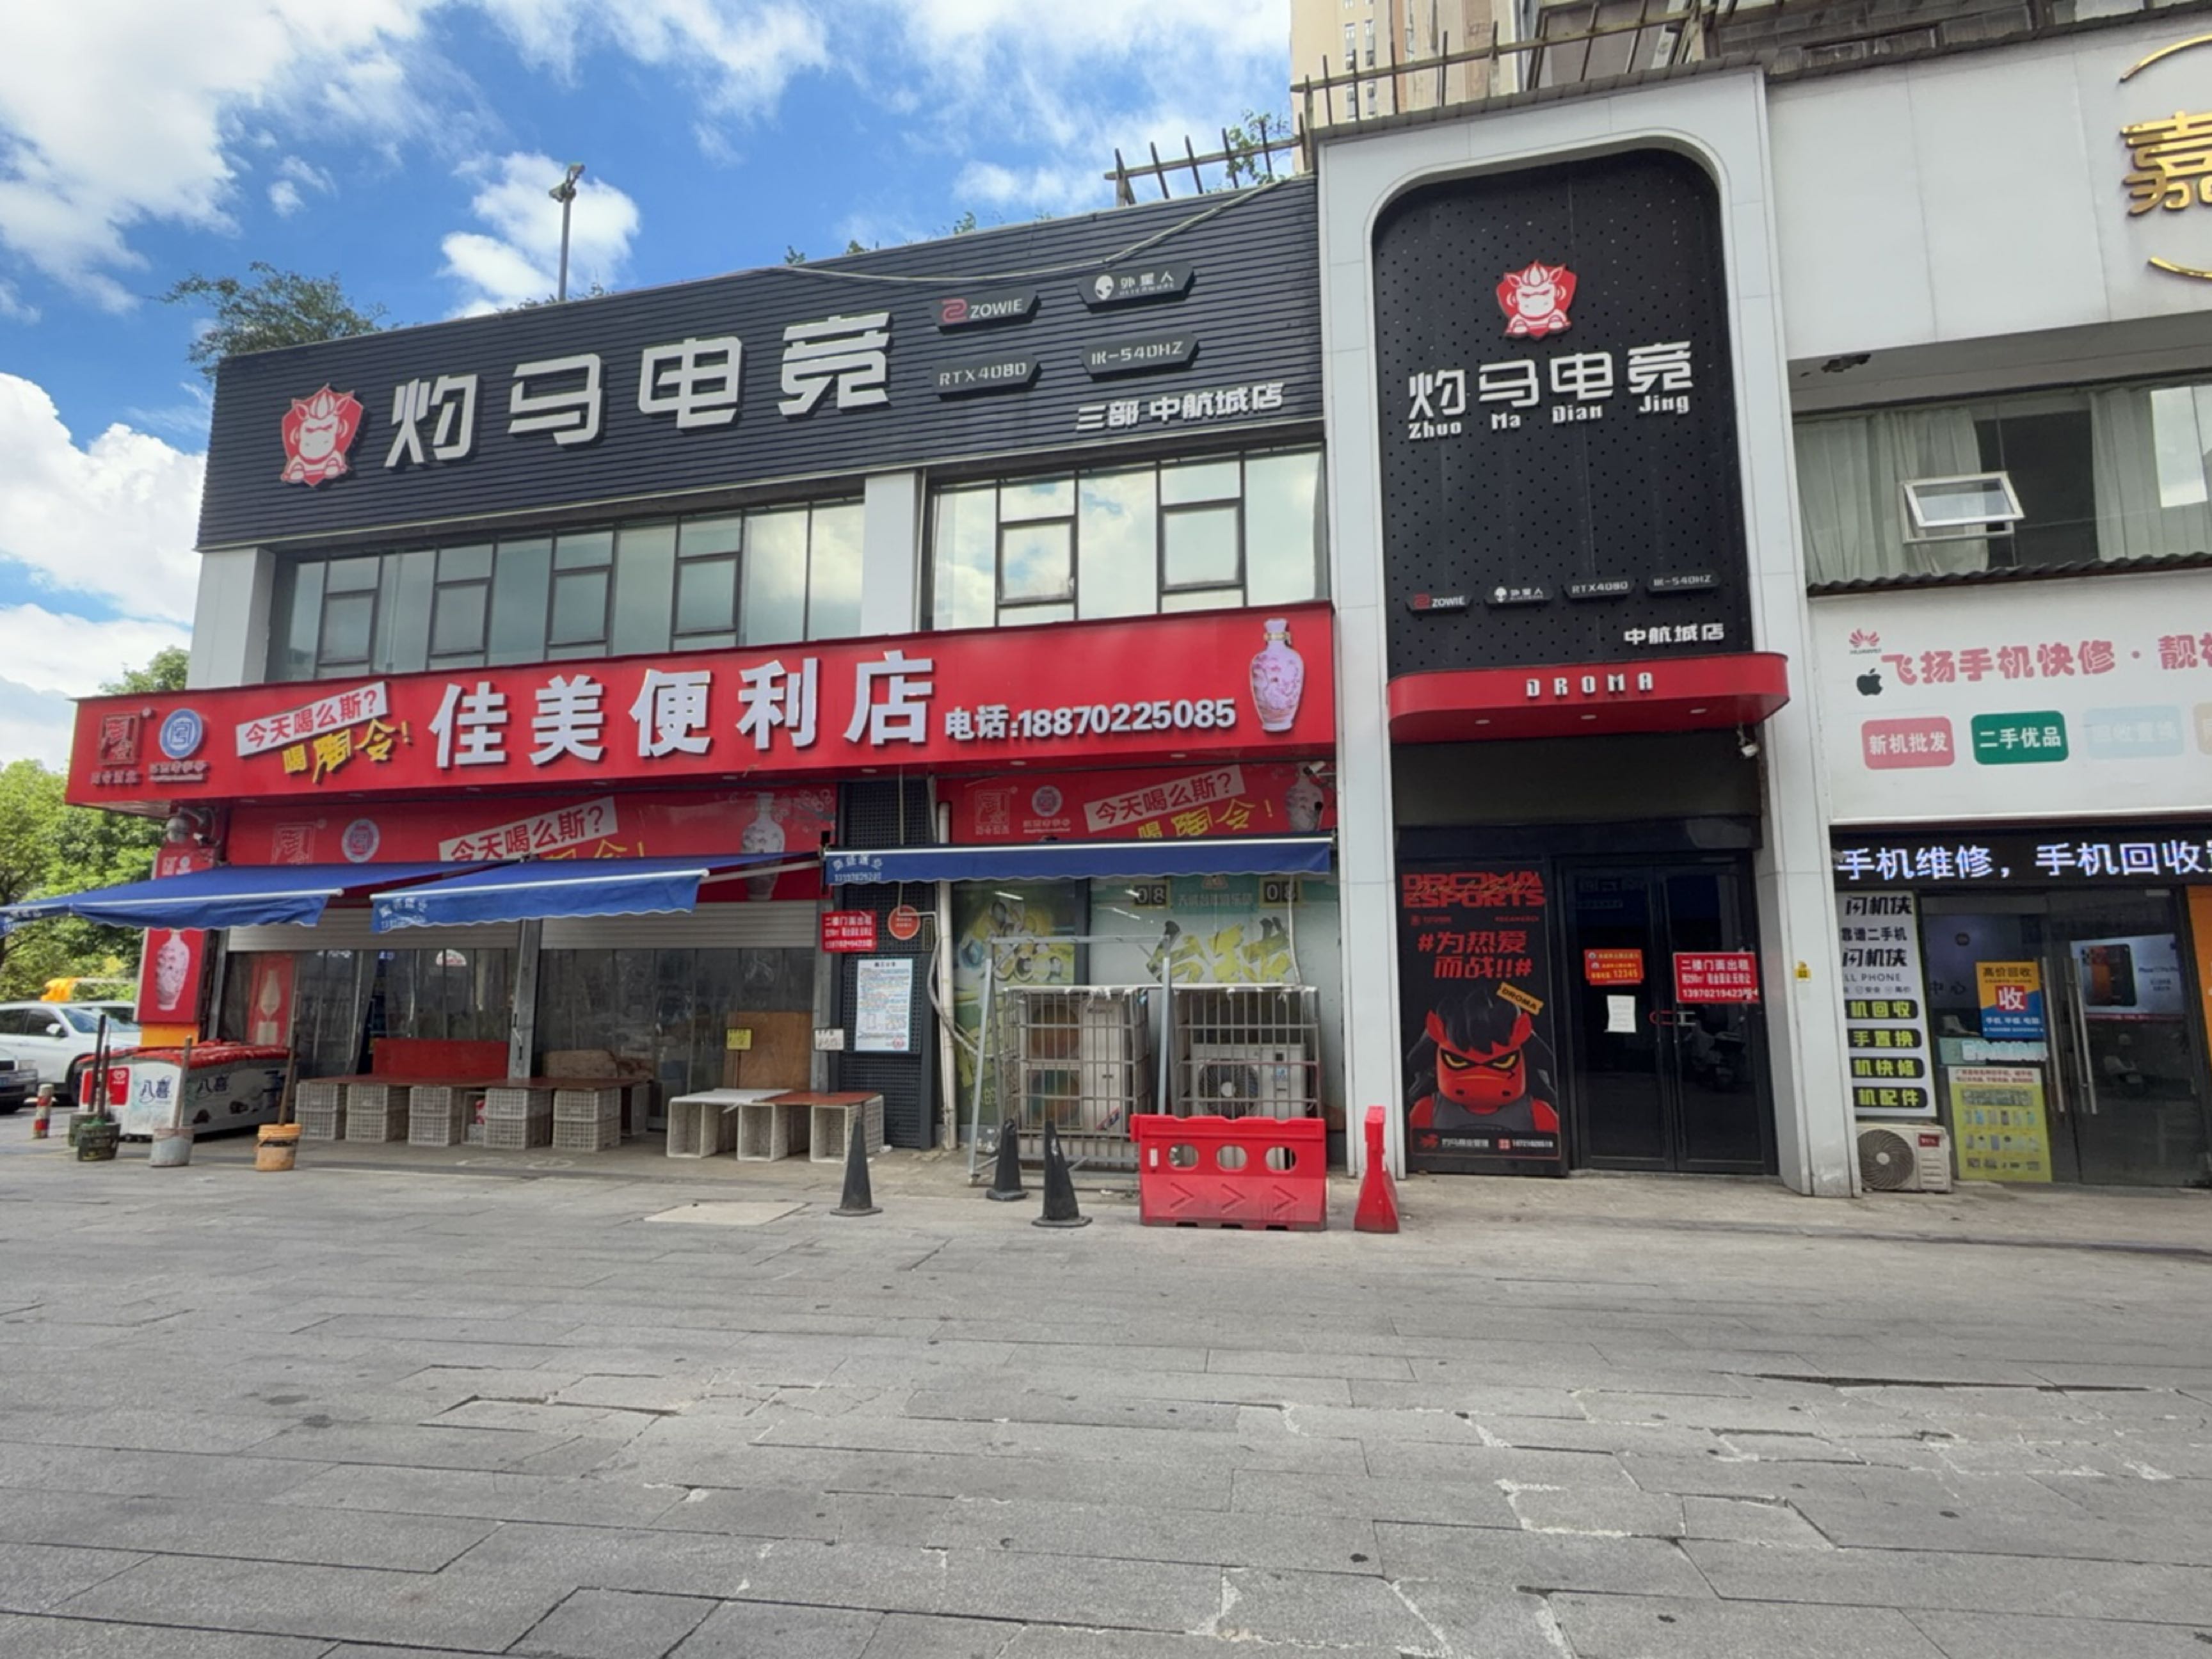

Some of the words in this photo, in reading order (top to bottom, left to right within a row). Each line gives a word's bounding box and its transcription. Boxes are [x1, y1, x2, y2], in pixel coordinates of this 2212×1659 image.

[970, 299, 1023, 319] ZOWIE
[939, 362, 1027, 387] RTX4080
[1408, 341, 1694, 420] 灼马电竞
[385, 312, 893, 469] 灼马电竞
[1076, 400, 1139, 431] 三部
[1148, 382, 1284, 423] 中航城店
[1409, 420, 1462, 440] Zhuo
[1491, 413, 1521, 430] Ma
[1551, 405, 1603, 423] Dian
[1639, 394, 1690, 415] Jing
[1623, 623, 1724, 646] 中航城店
[1526, 672, 1653, 698] DROMA
[245, 689, 378, 748] 今天喝么斯？
[428, 649, 934, 769] 佳美便利店
[944, 698, 1237, 741] 电话:18870225085
[1868, 731, 1950, 755] 新机批发
[1978, 726, 2062, 749] 二手优品
[1095, 772, 1232, 824] 今天喝么斯？
[1837, 842, 2212, 881] 手机维修，手机回收
[1845, 896, 1912, 916] 闪机侠
[1418, 931, 1527, 954] #为热爱
[1843, 949, 1907, 967] 闪机侠
[1862, 973, 1901, 982] PHONE
[1502, 988, 1538, 1011] DROMA
[1851, 1000, 1911, 1018] 机回收
[1998, 986, 2025, 1010] 收
[1854, 1030, 1913, 1047] 手置换
[1853, 1059, 1916, 1077] 机快修
[1858, 1088, 1919, 1106] 机配件
